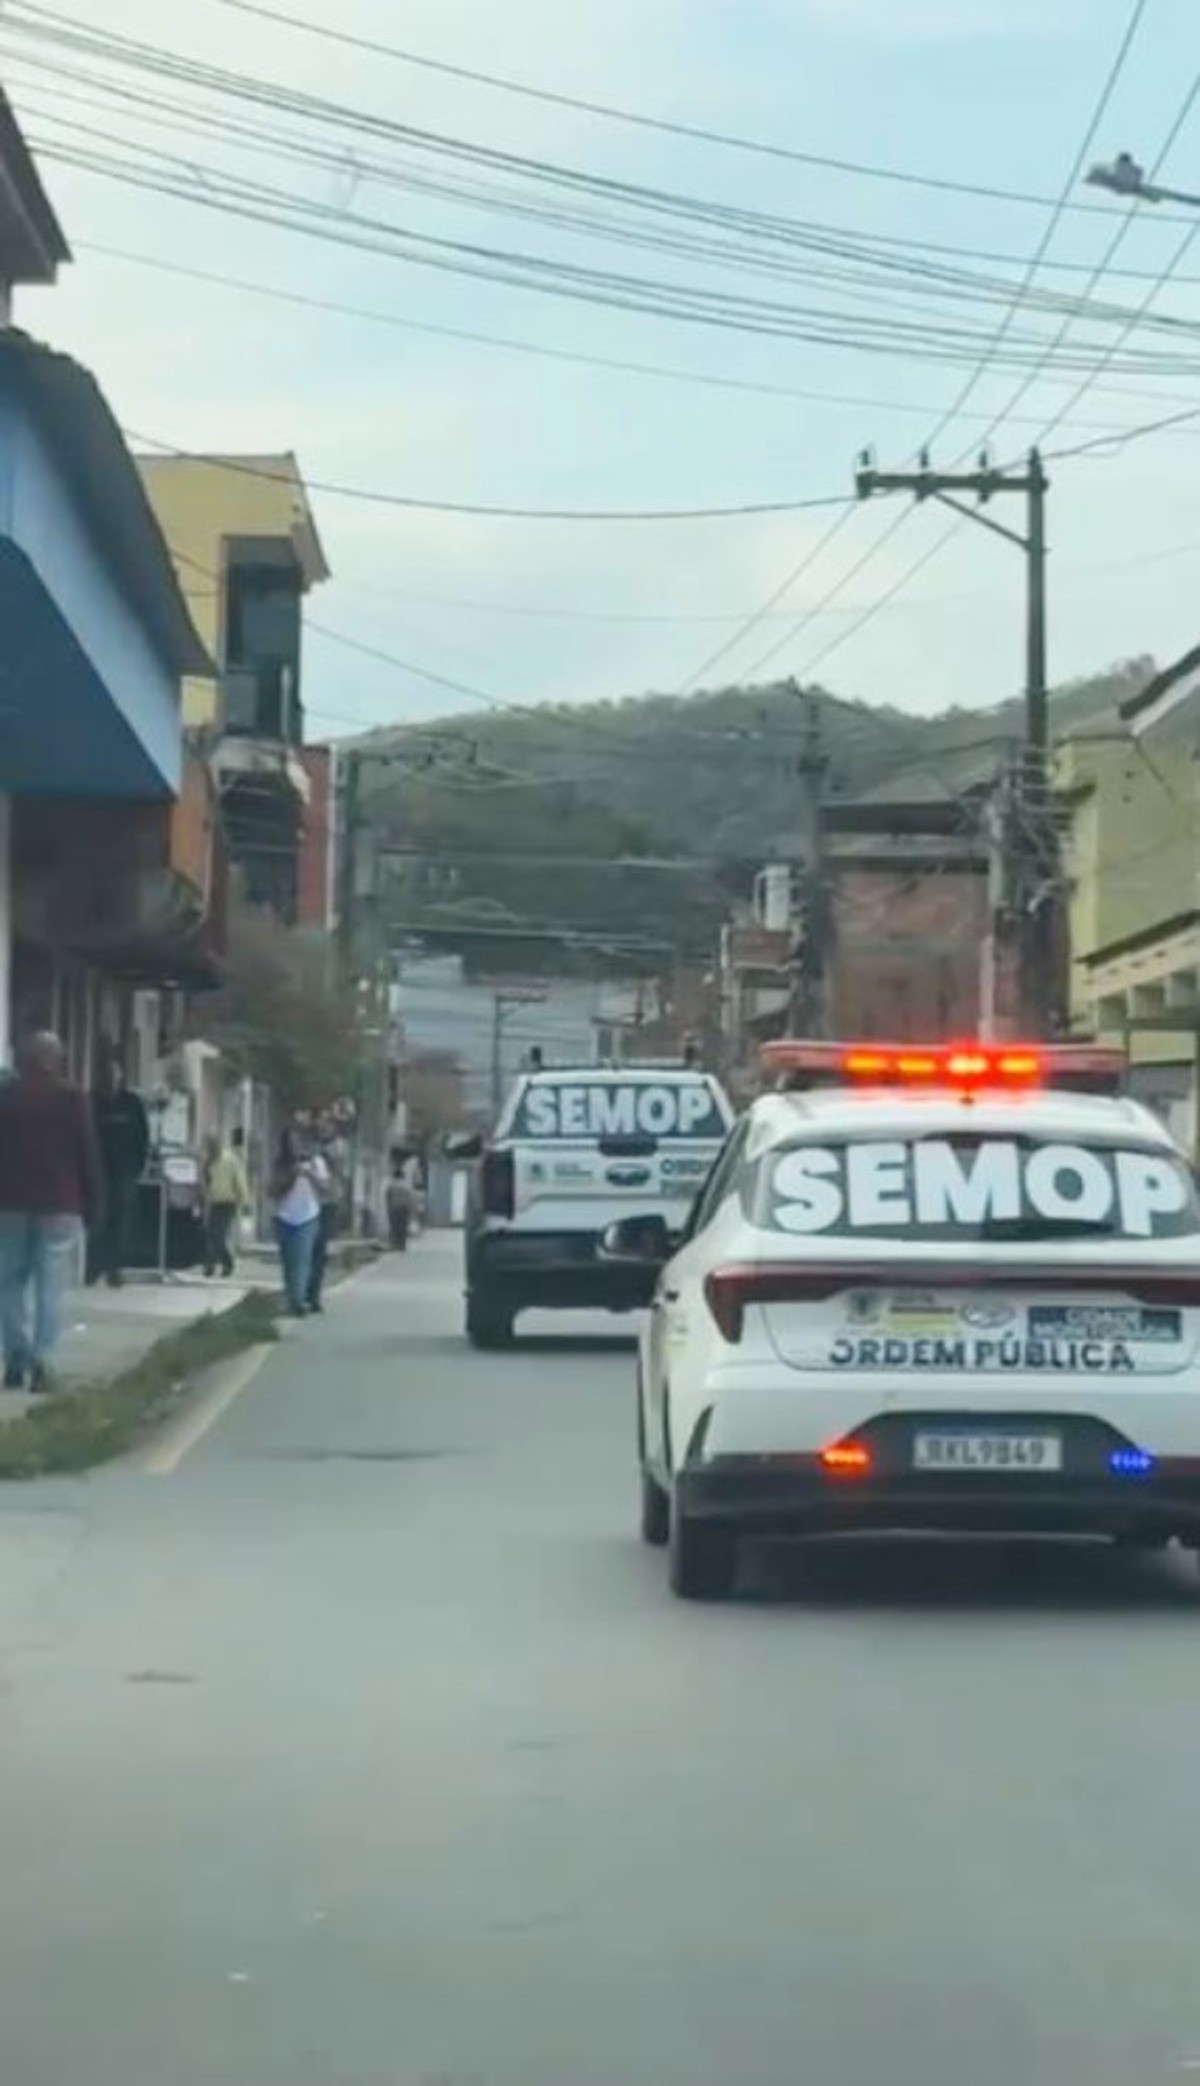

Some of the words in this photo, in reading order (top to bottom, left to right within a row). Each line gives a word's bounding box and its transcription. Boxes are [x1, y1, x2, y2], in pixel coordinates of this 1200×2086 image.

[524, 1086, 712, 1135] SEMOP
[773, 1141, 1187, 1235] SEMOP
[829, 1338, 965, 1367] ORDEM
[974, 1331, 1136, 1370] PÚBLICA
